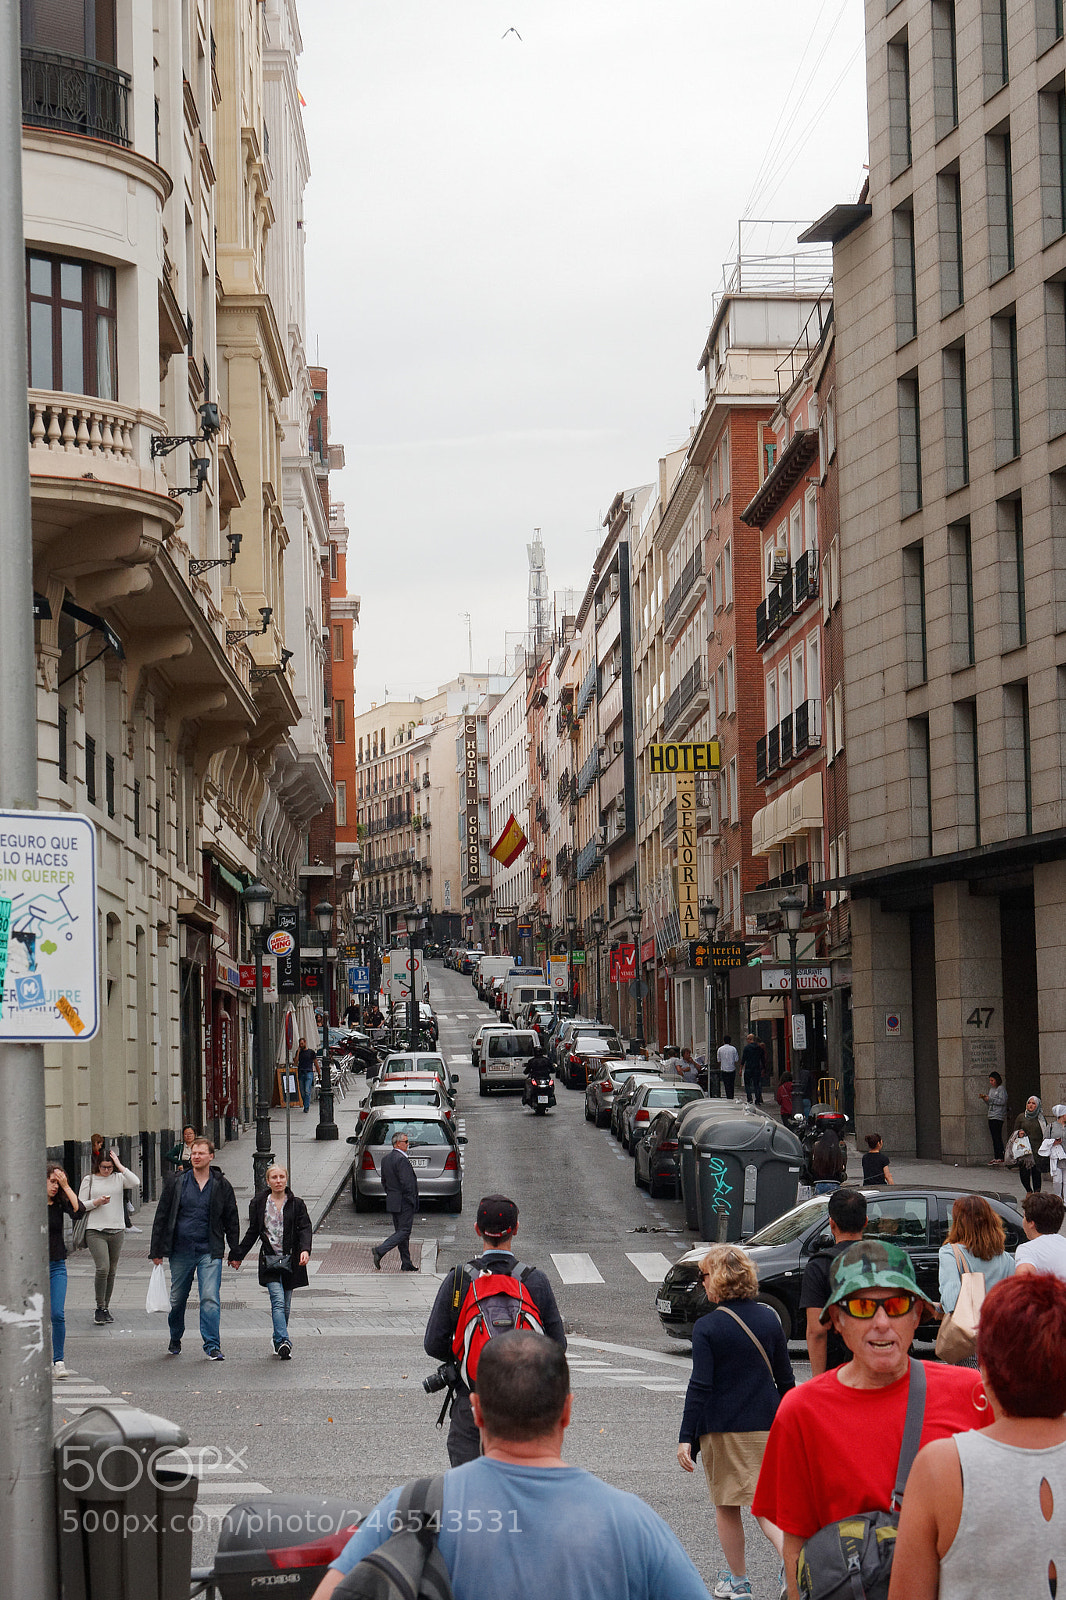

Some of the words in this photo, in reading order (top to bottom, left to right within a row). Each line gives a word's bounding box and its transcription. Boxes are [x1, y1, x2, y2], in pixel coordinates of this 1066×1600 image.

[467, 741, 476, 788] HOTEL
[651, 744, 720, 771] HOTEL
[0, 834, 46, 849] EGURO
[51, 837, 78, 850] QUE
[468, 816, 478, 874] COLOSO
[3, 851, 20, 865] LO
[25, 852, 68, 867] HACES
[22, 869, 75, 884] QUERER
[271, 935, 290, 945] BURGER
[271, 940, 291, 950] KING
[796, 968, 823, 976] ESTAURANTE
[44, 989, 82, 1003] UIERE
[966, 1007, 995, 1029] 47
